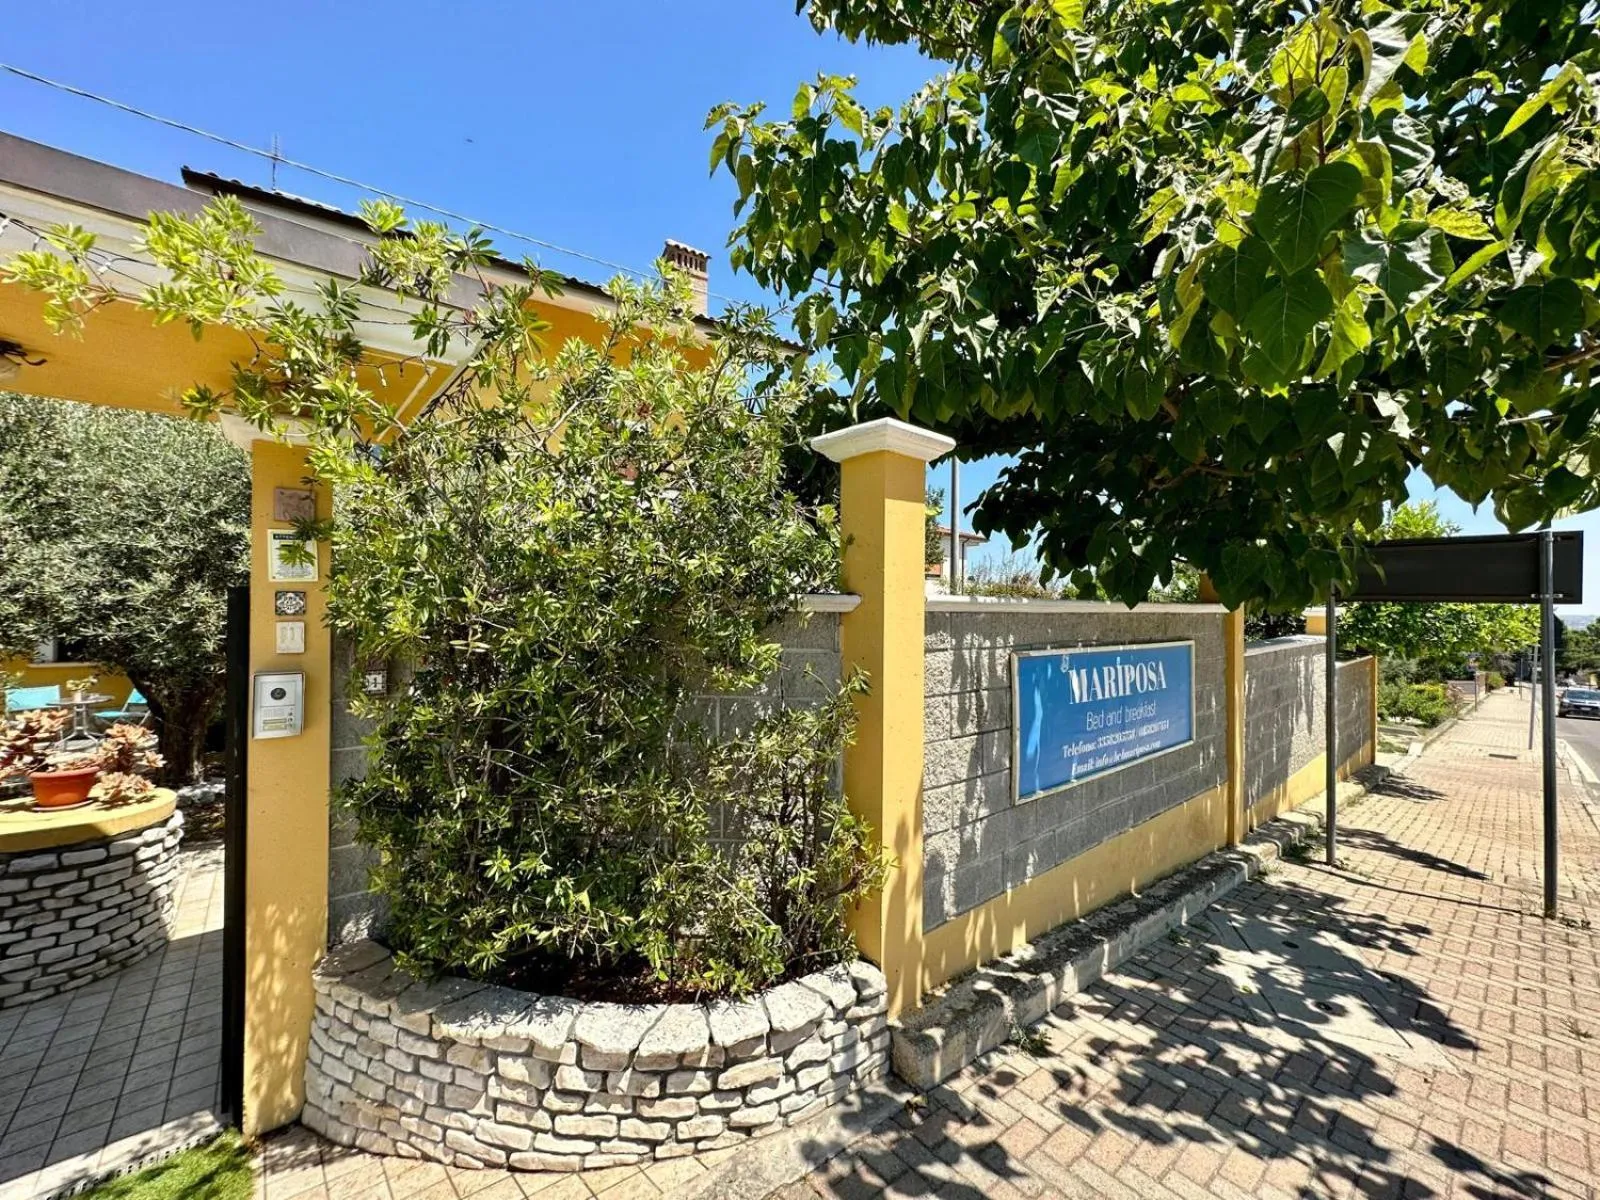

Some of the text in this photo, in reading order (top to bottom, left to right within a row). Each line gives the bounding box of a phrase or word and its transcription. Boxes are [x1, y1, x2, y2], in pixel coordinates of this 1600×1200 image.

[1068, 657, 1167, 705] MARIPOSA
[1086, 700, 1156, 731] Bed and breakfast
